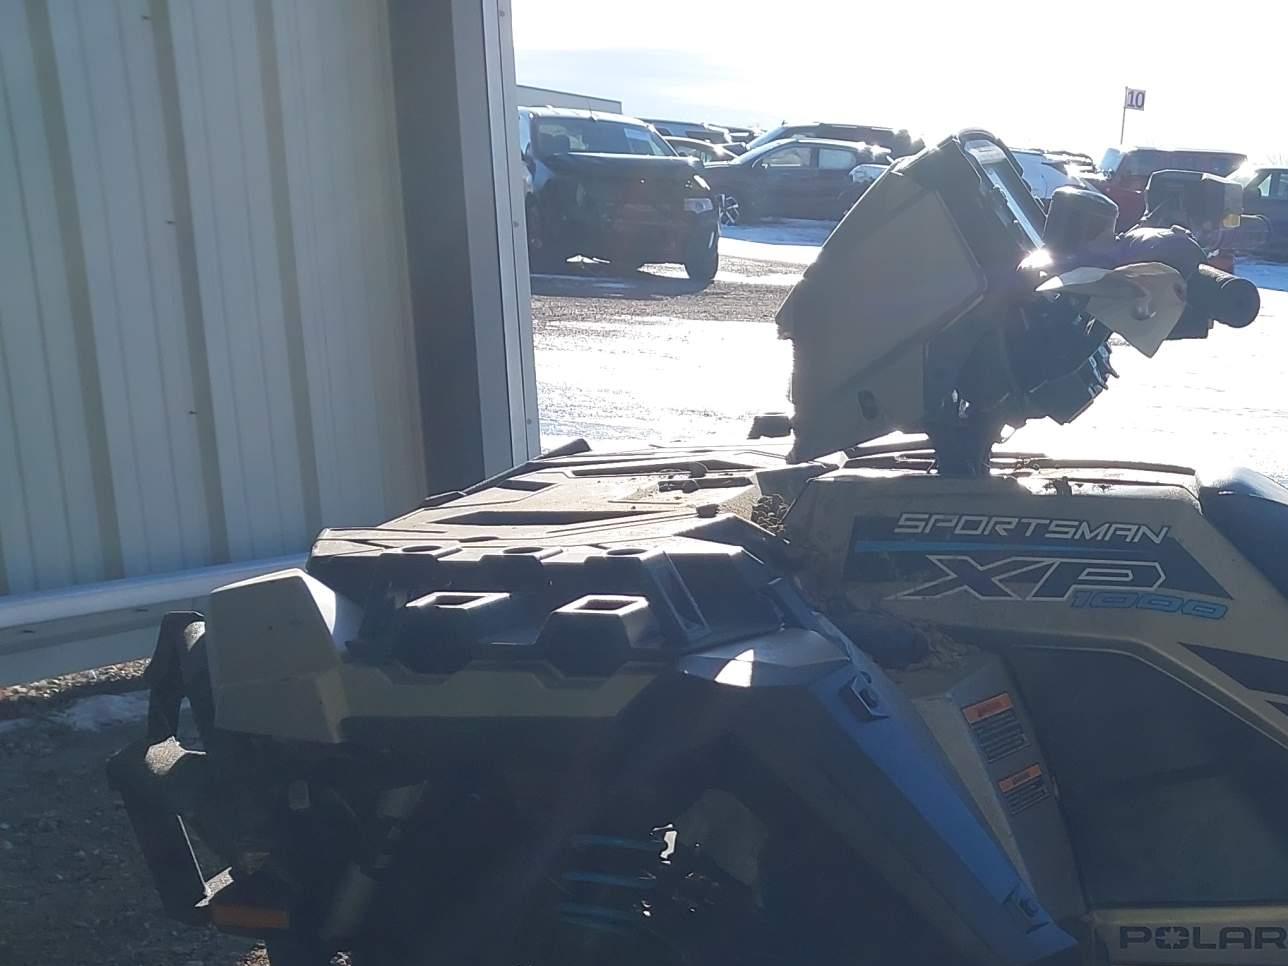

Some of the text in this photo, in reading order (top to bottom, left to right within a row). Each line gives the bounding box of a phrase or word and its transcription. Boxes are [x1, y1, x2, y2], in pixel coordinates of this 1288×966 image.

[1127, 90, 1145, 108] 10
[894, 512, 1169, 544] SPORTSMAN
[888, 554, 1167, 600] XP
[1071, 591, 1229, 620] 1000
